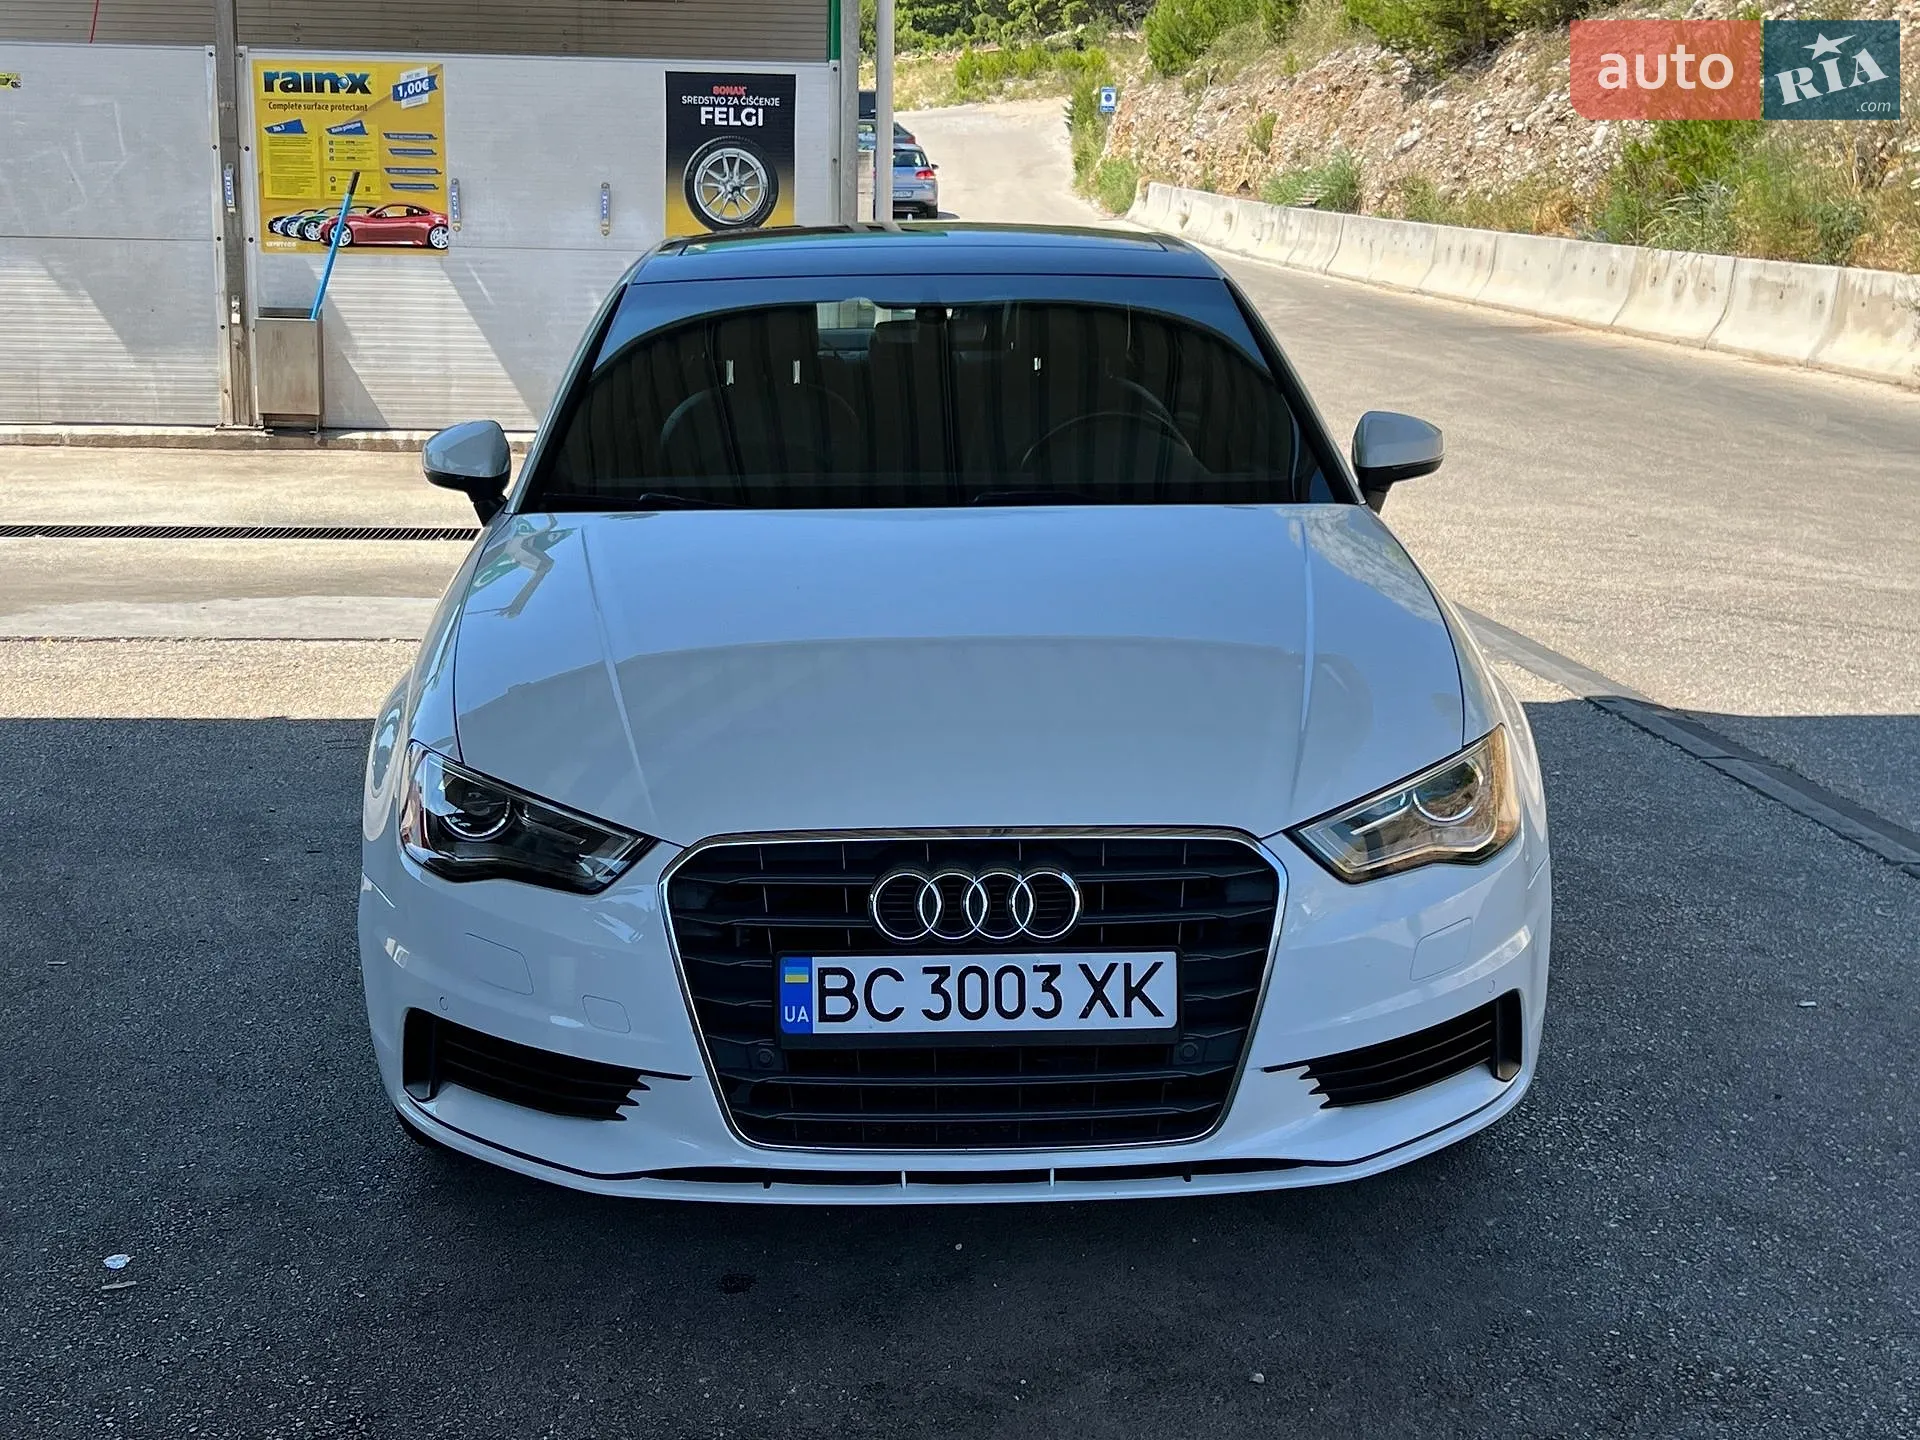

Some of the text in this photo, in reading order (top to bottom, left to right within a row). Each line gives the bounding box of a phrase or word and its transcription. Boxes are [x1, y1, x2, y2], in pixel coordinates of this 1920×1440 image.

[397, 78, 430, 98] 1,00€
[268, 101, 368, 112] Complete surface protectant
[681, 95, 726, 105] SREDSTVO
[727, 97, 739, 105] ZA
[700, 106, 764, 127] FELGI
[818, 961, 1164, 1023] BC 3003 XK
[784, 1005, 809, 1024] UA
